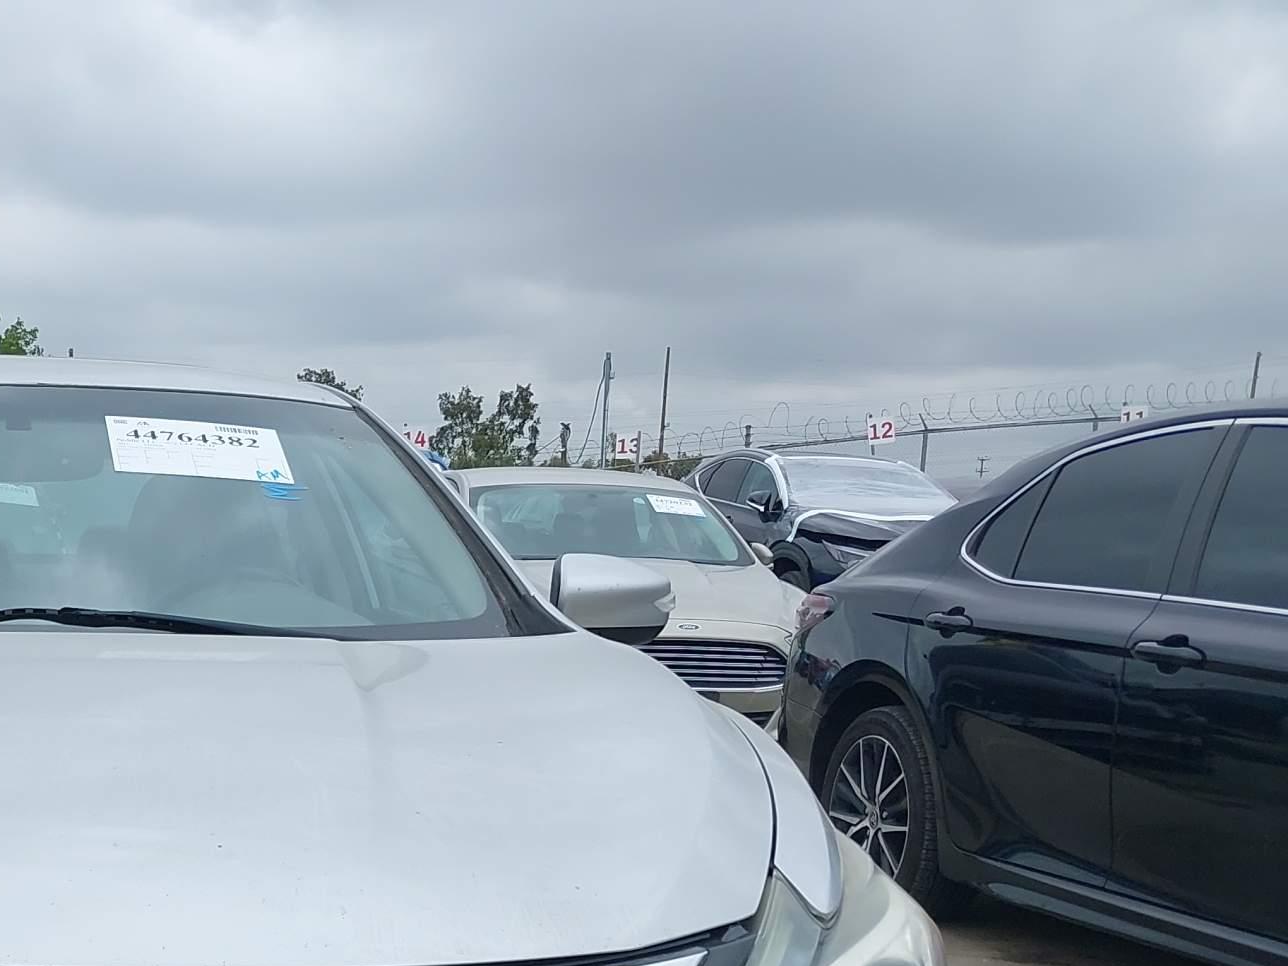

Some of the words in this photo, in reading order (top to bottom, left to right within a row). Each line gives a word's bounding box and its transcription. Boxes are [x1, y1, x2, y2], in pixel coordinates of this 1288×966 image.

[126, 429, 260, 448] 44764382
[868, 421, 894, 440] 12
[617, 438, 639, 454] 13
